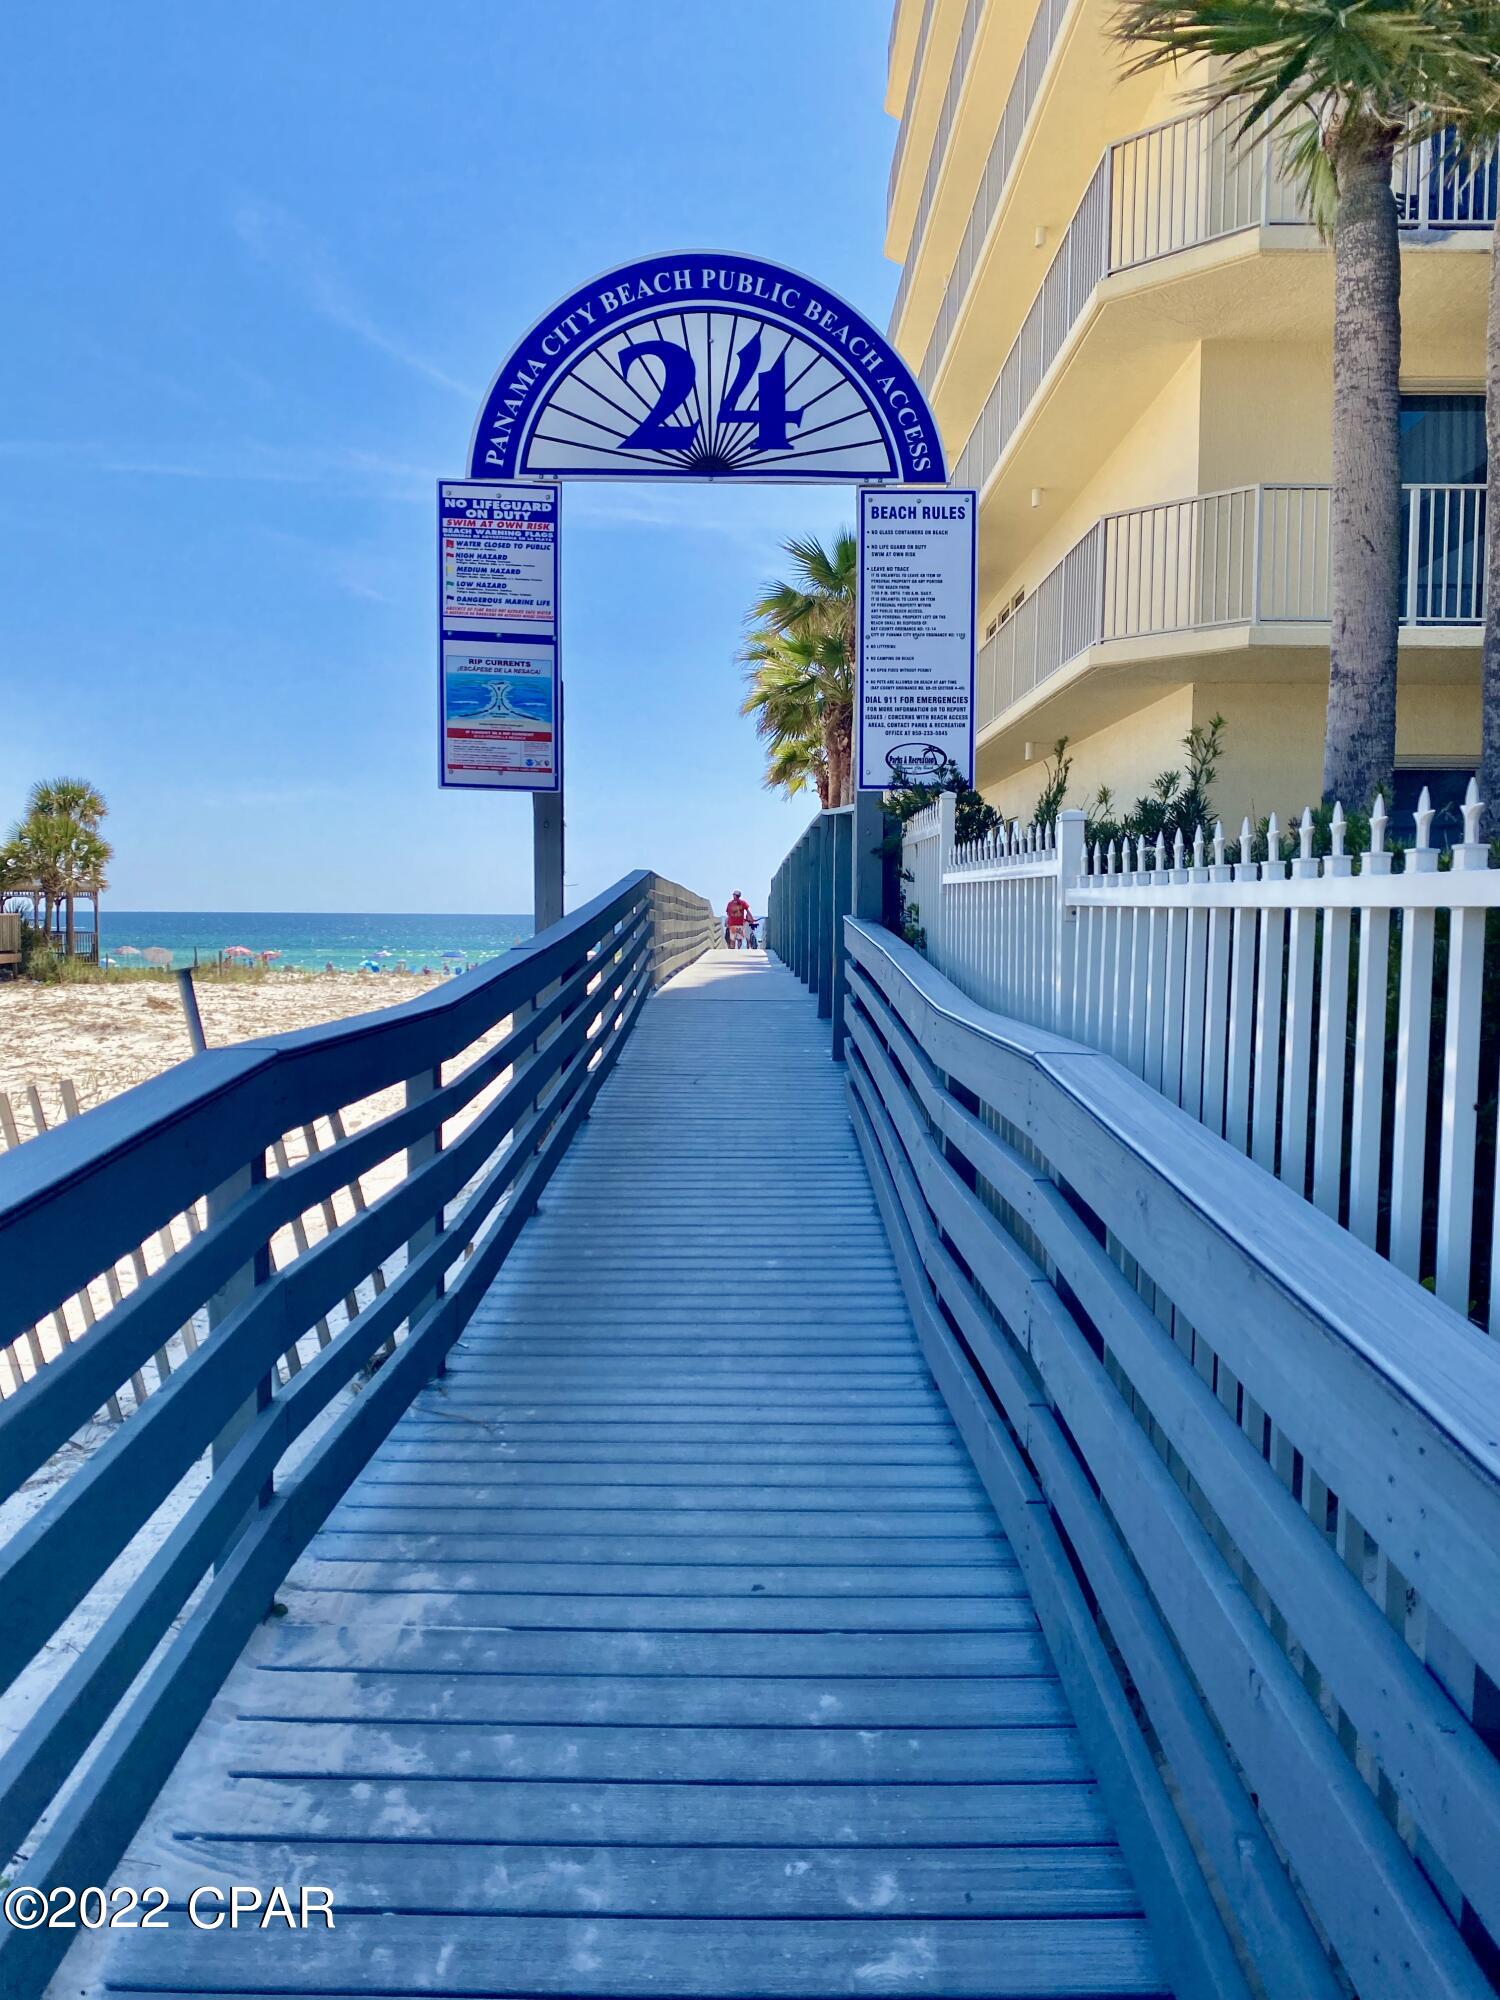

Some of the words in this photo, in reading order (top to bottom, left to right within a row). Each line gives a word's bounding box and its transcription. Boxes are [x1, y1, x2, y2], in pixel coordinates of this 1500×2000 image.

[486, 359, 543, 467] PANAMA
[541, 305, 598, 357] CITY
[599, 269, 692, 315] BEACH
[702, 269, 801, 309] PUBLIC
[802, 301, 885, 373] BEACH
[877, 376, 931, 472] ACCESS
[616, 332, 805, 450] 24
[445, 499, 467, 508] NO
[473, 500, 552, 512] LIFEGUARD
[466, 509, 488, 518] ON
[494, 511, 531, 520] DUTY
[872, 506, 916, 520] BEACH
[923, 506, 965, 520] RULES
[447, 519, 476, 527] SWIM
[497, 521, 523, 529] OWN
[527, 522, 550, 530] RISK
[476, 529, 522, 537] WARNING
[457, 596, 502, 604] DANGEROUS
[505, 597, 533, 606] MARINE
[486, 659, 531, 667] CURRENTS
[866, 696, 882, 704] DIAL
[884, 696, 897, 704] 911
[900, 696, 914, 704] FOR
[917, 696, 968, 704] EMERGENCIES
[890, 755, 903, 765] Parks
